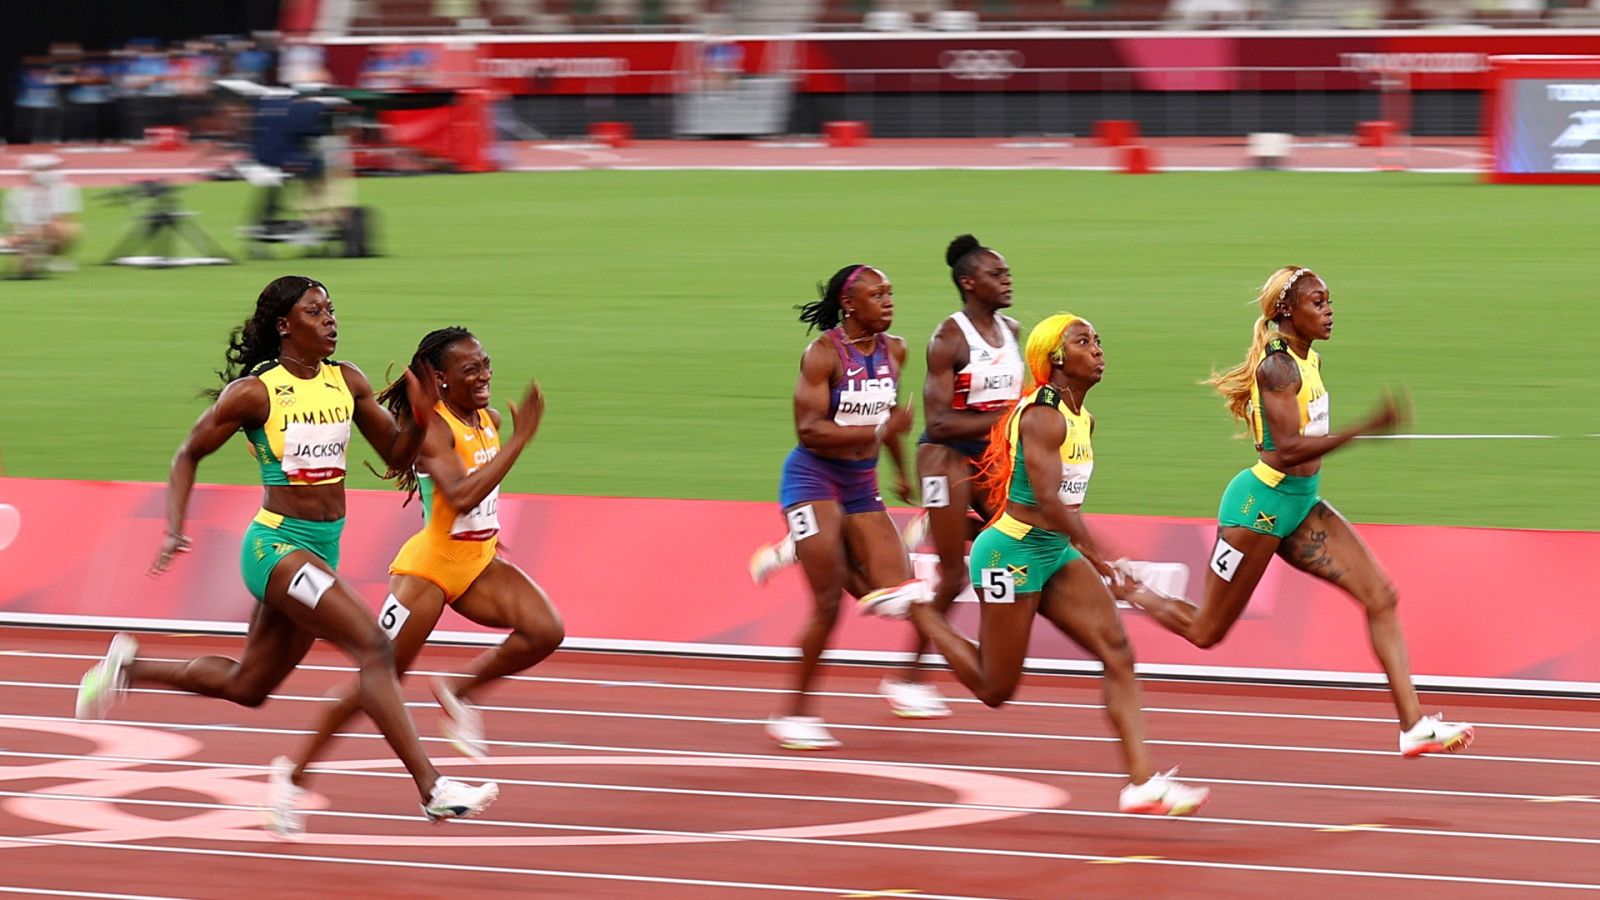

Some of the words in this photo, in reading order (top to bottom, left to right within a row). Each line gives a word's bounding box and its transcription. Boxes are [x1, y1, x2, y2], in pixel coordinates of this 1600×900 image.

[279, 406, 350, 432] JAMAICA
[293, 442, 346, 457] JACKSON
[925, 480, 941, 503] 2
[793, 512, 810, 535] 3
[1216, 549, 1232, 573] 4
[294, 571, 320, 599] 7
[990, 571, 1006, 599] 5
[381, 604, 397, 630] 6
